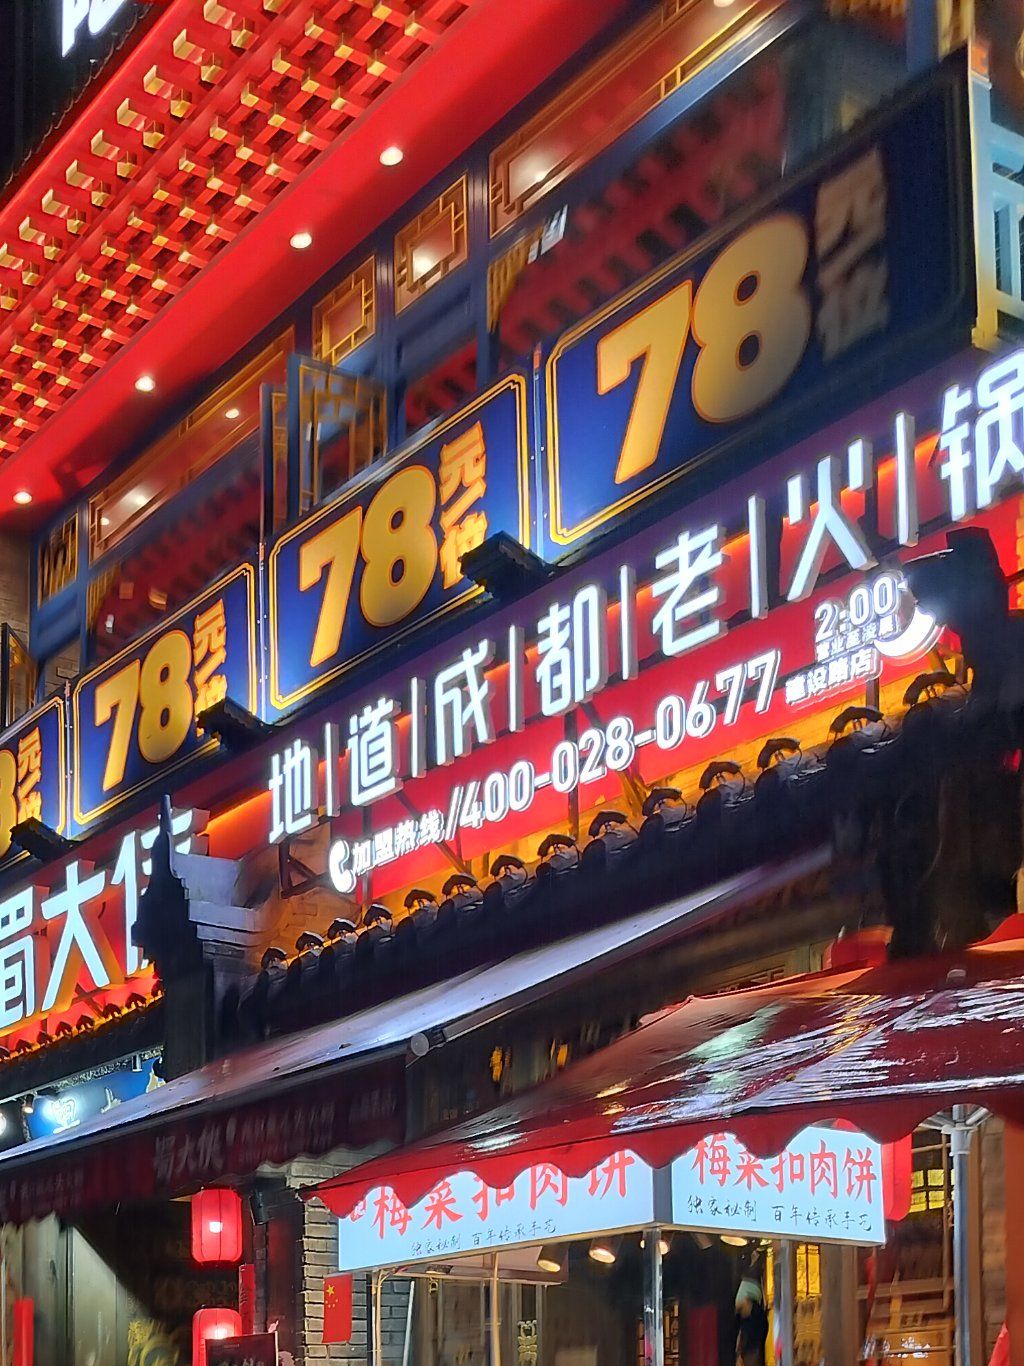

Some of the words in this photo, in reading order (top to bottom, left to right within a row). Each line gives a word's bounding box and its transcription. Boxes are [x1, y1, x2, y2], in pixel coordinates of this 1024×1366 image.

[597, 210, 811, 485] 78
[299, 464, 438, 668] 78
[814, 575, 898, 643] 2:00
[95, 629, 193, 792] 78
